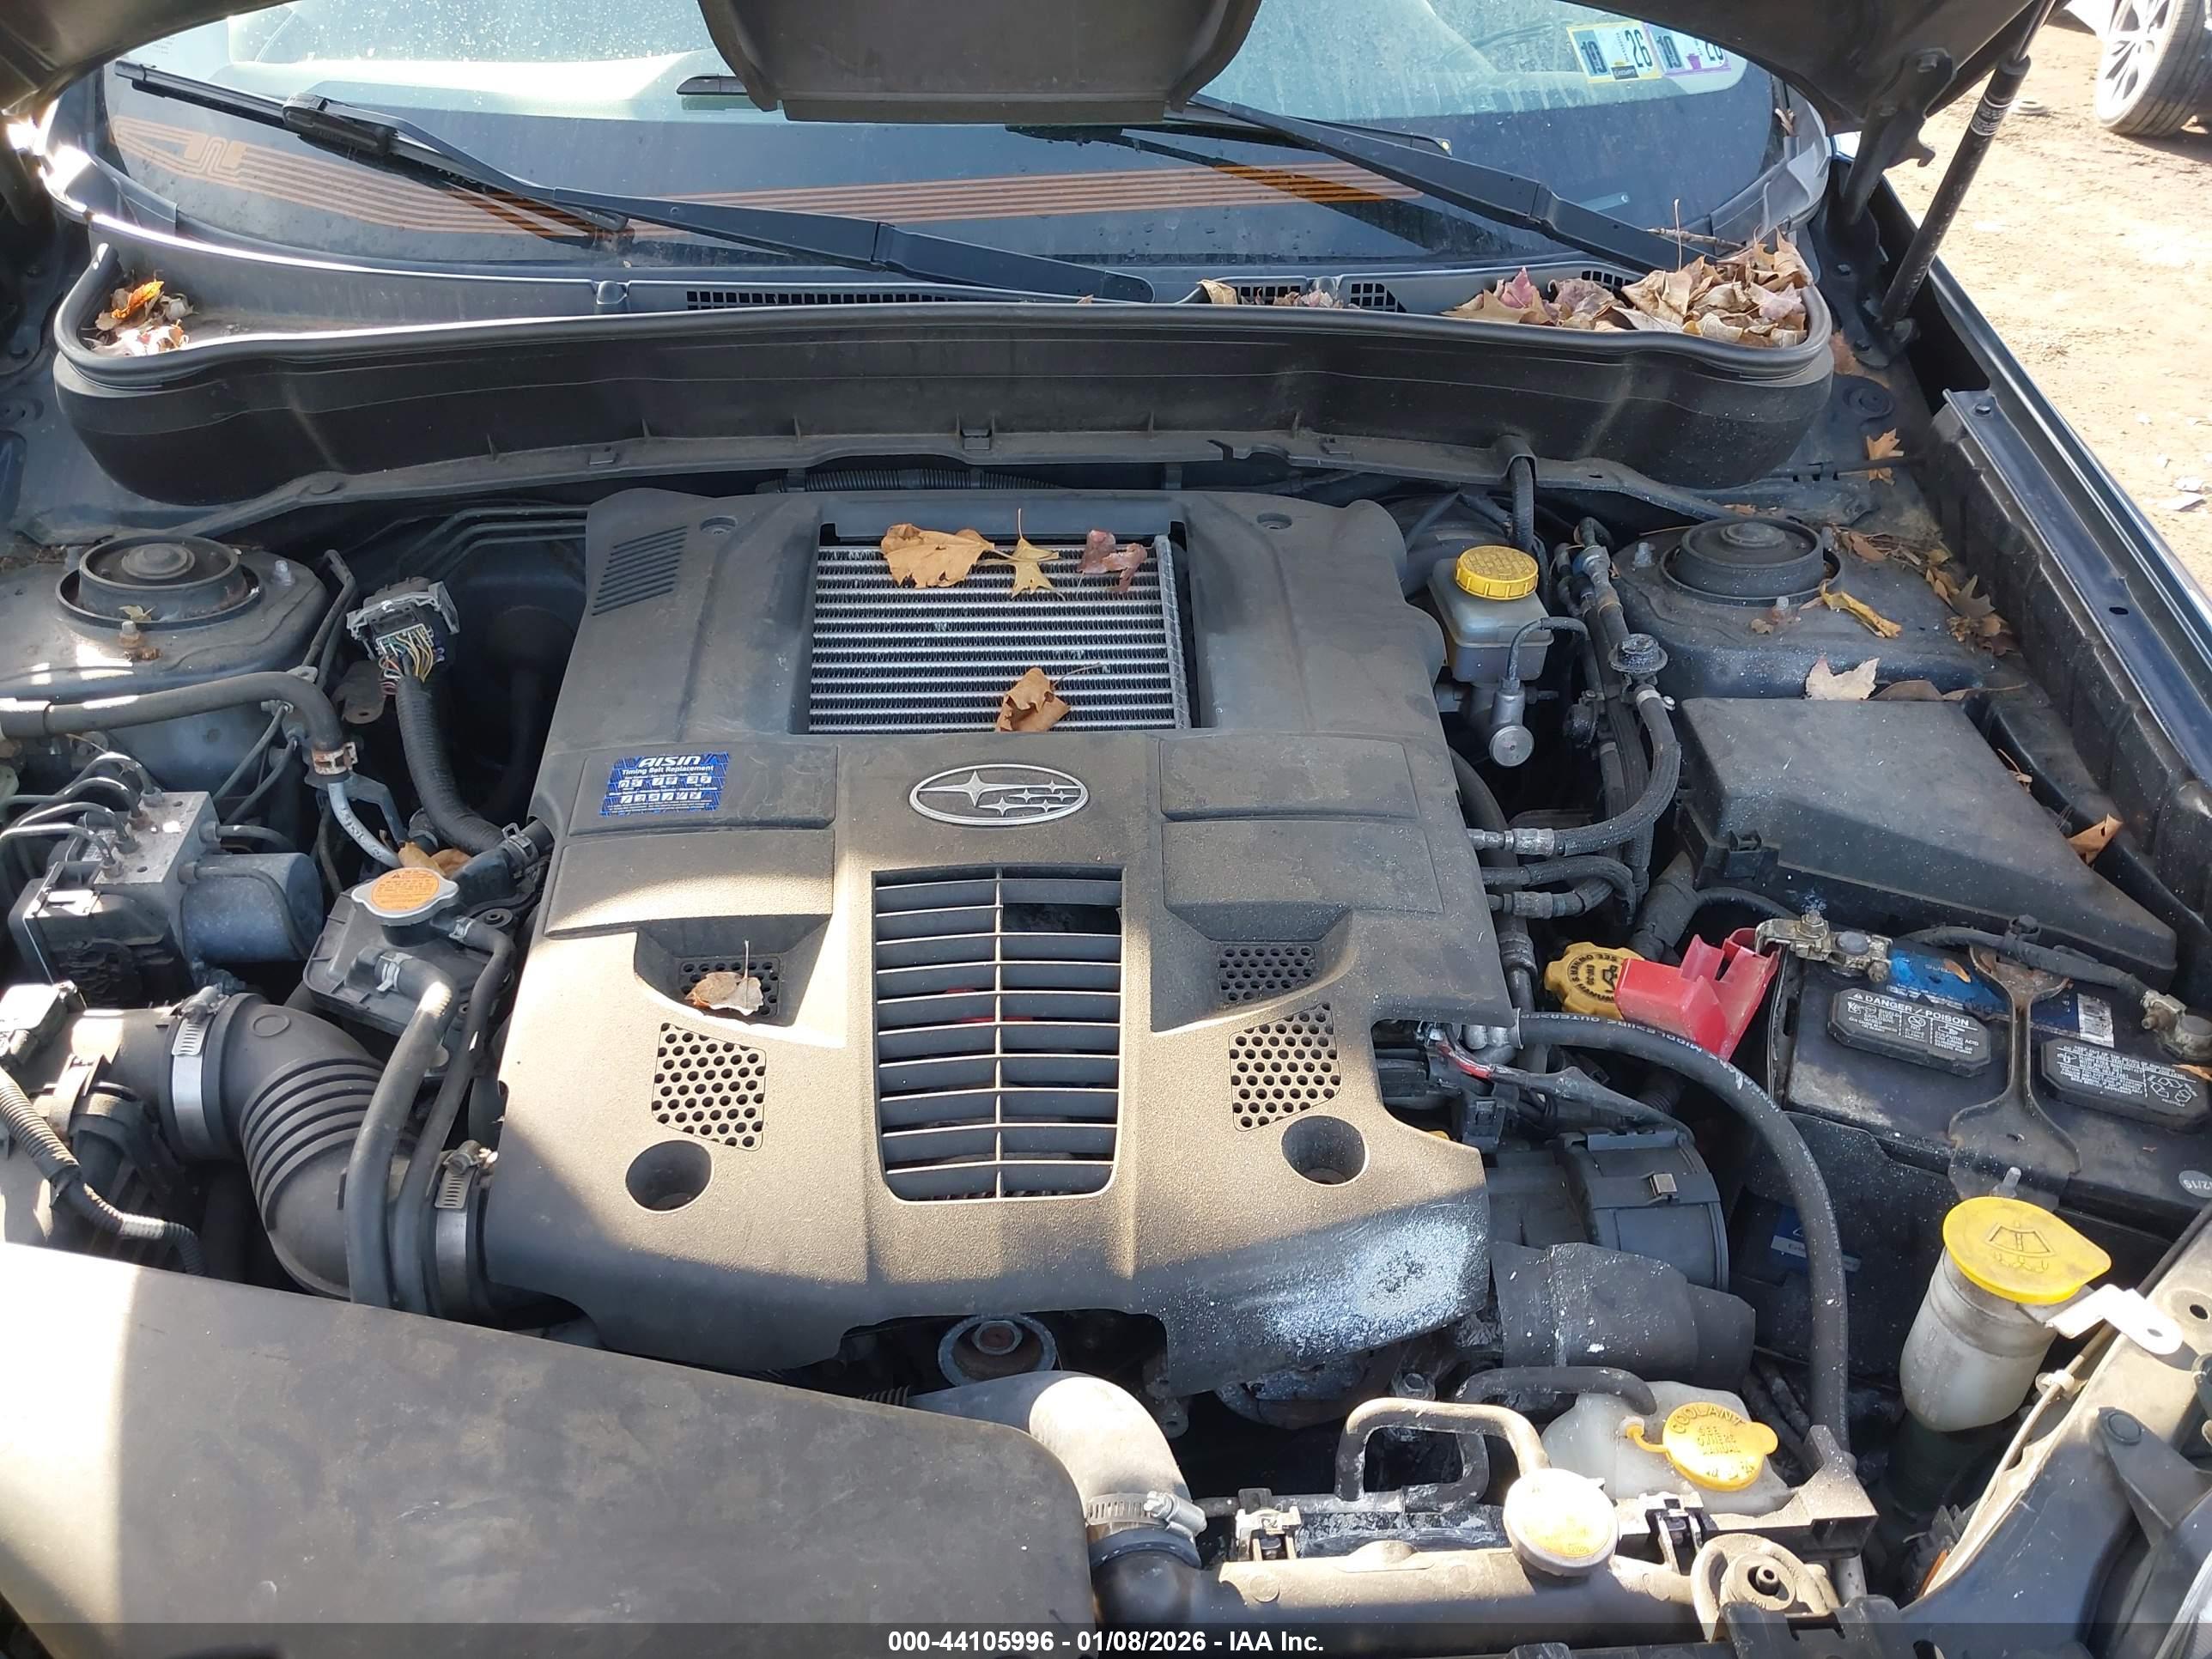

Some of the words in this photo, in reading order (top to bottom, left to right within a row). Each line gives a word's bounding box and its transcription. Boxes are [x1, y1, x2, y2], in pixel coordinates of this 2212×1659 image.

[639, 756, 702, 768] AISIN
[665, 765, 714, 774] Replacement
[1576, 984, 1615, 1003] MANUA
[1865, 995, 1913, 1012] DANGER
[1925, 1010, 1970, 1026] POISON
[1670, 1404, 1747, 1435] COOLANT
